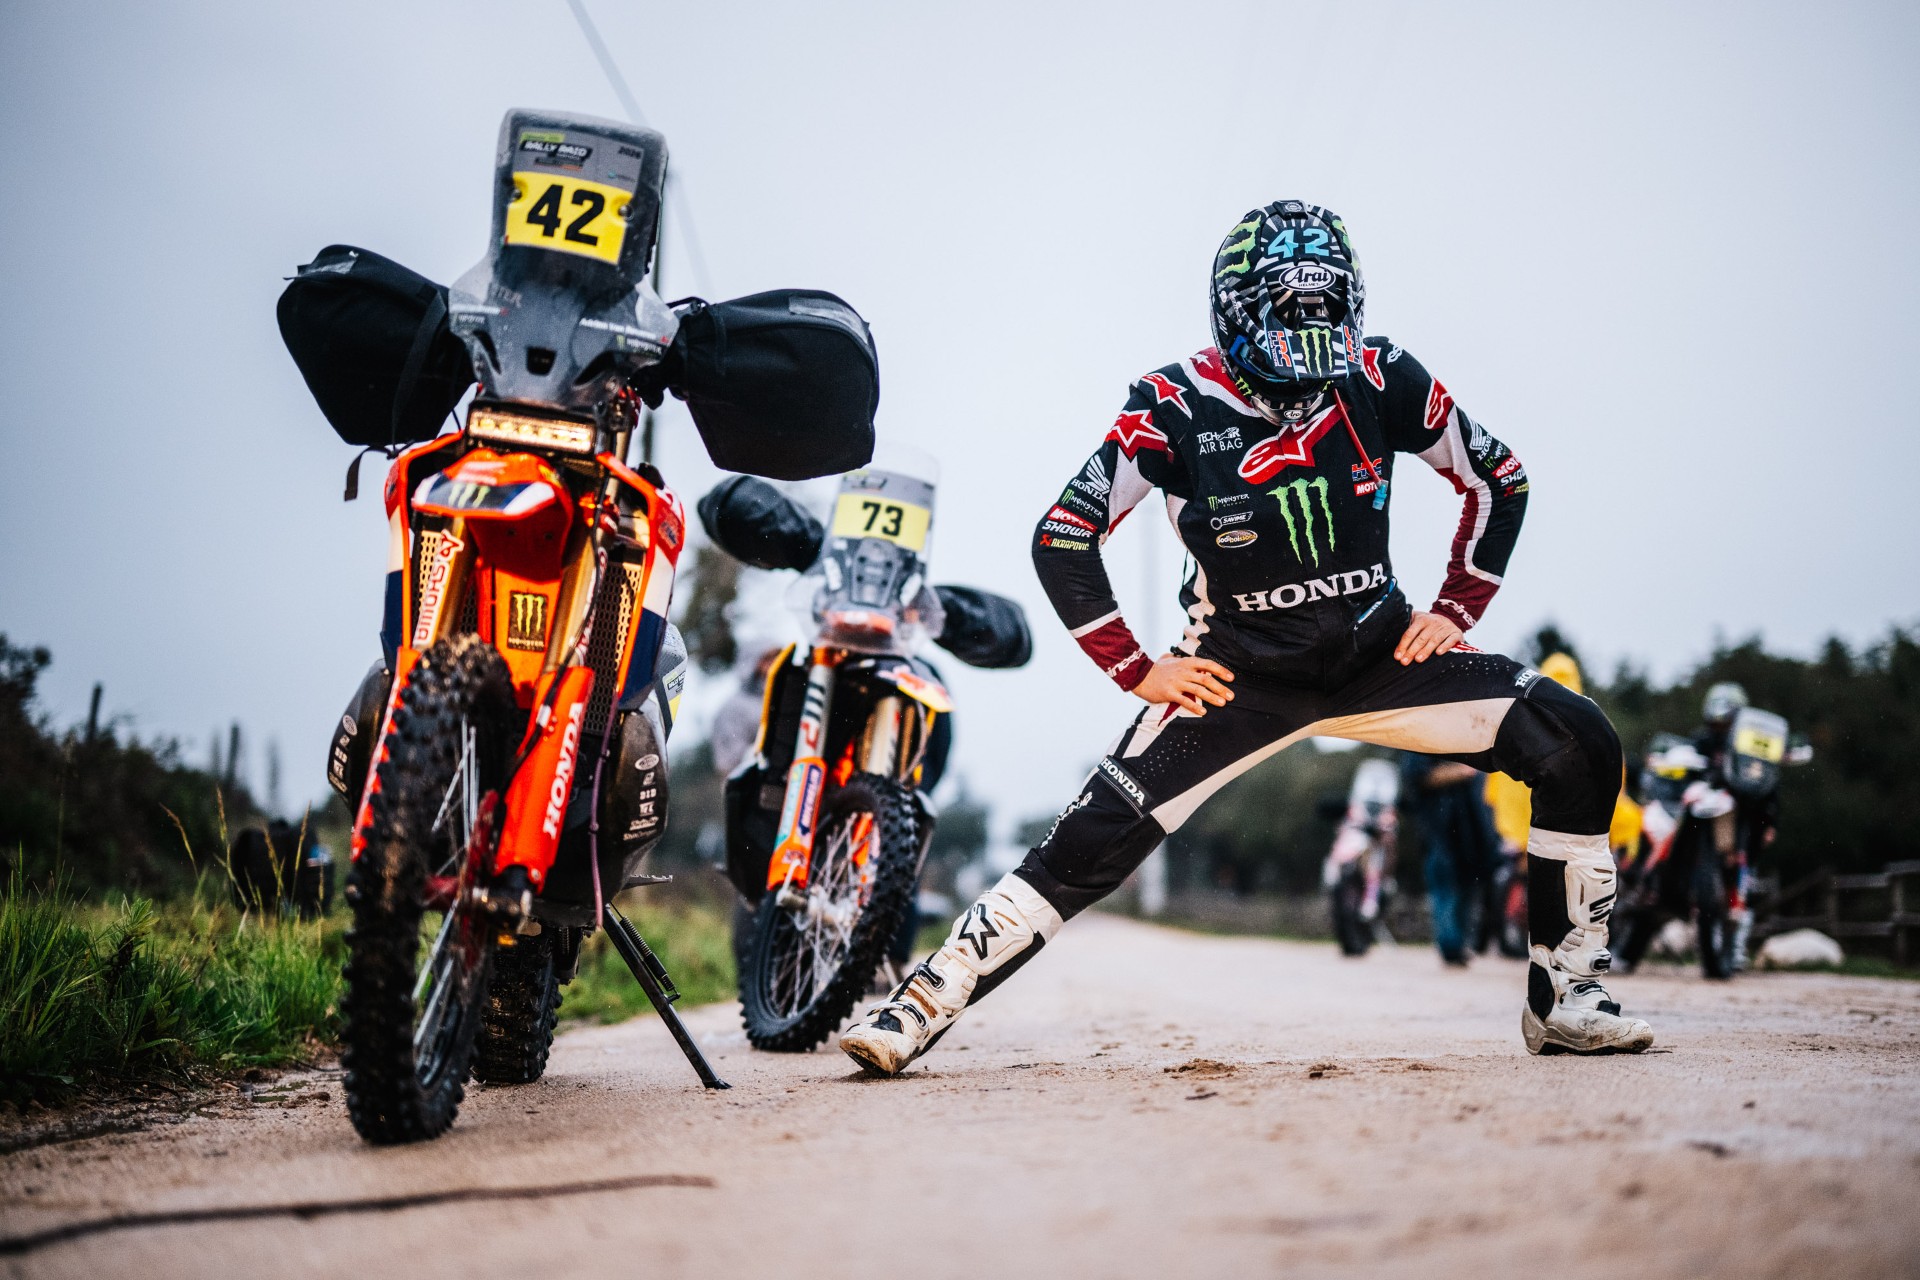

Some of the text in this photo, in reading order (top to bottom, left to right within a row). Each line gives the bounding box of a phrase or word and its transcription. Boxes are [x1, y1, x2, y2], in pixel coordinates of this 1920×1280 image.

[526, 184, 606, 247] 42
[1267, 228, 1330, 258] 42
[1285, 267, 1329, 284] Arai
[1199, 438, 1243, 455] AIR BAG
[1496, 457, 1520, 477] MOT
[1071, 479, 1108, 507] HONDA
[1217, 493, 1250, 504] MONSTER
[1356, 482, 1378, 495] MOT
[862, 501, 904, 537] 73
[1070, 495, 1104, 518] MONSTER
[1042, 520, 1093, 538] SHOWA
[1232, 563, 1387, 612] HONDA
[542, 702, 584, 840] HONDA
[1100, 758, 1145, 806] HONDA
